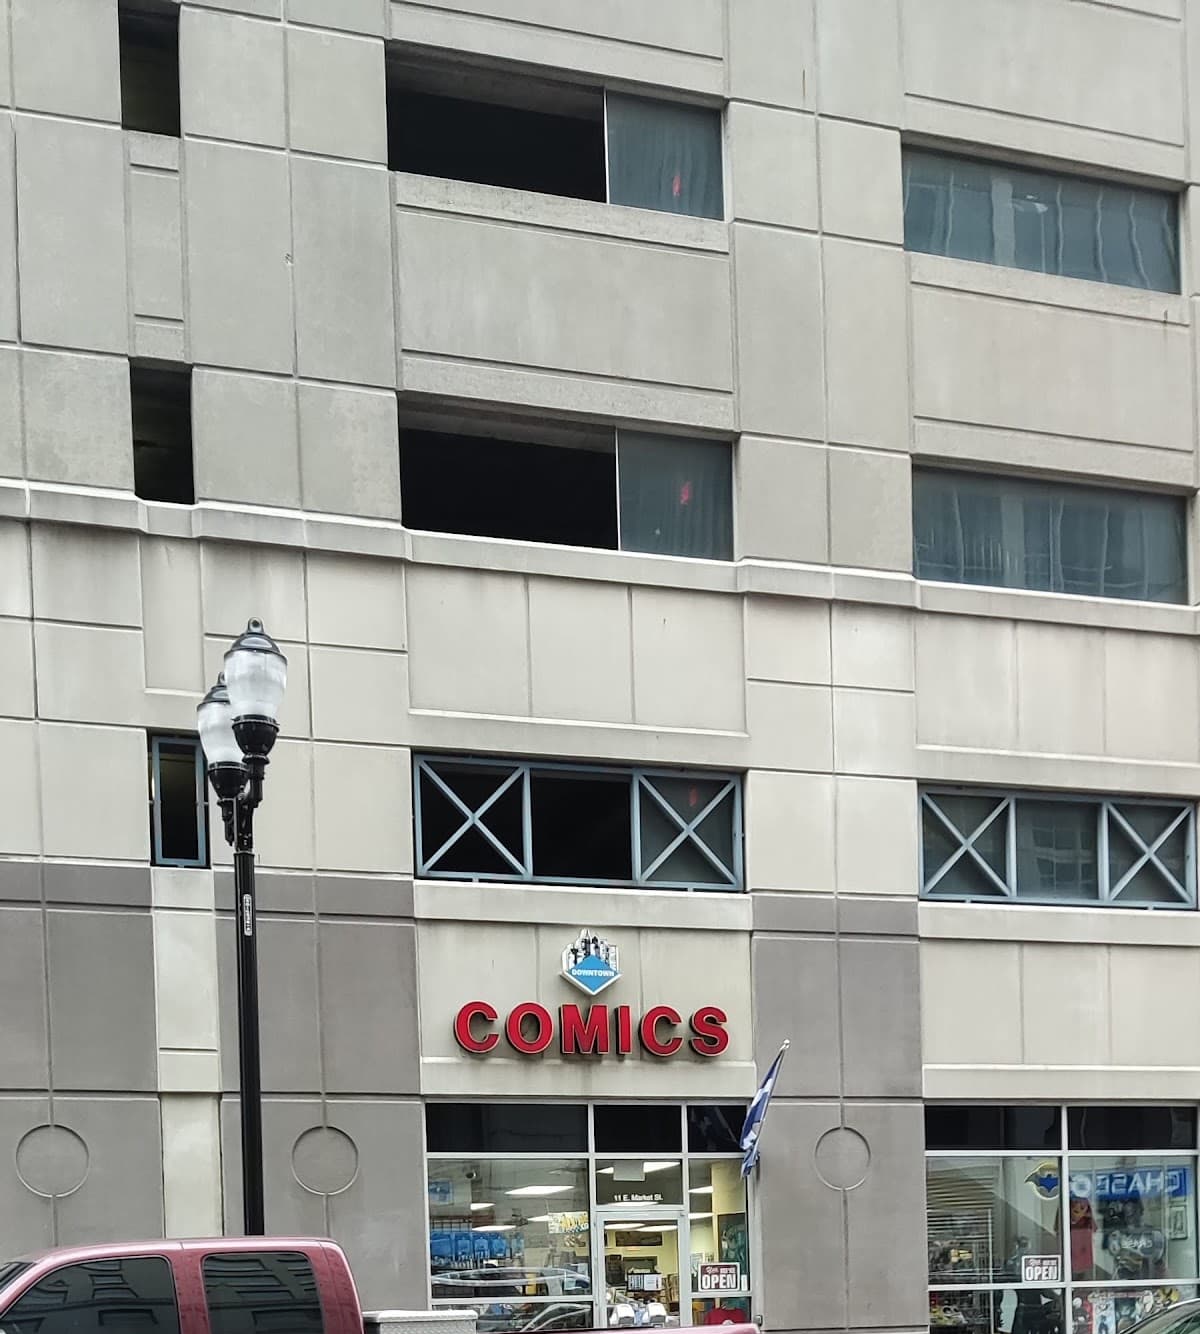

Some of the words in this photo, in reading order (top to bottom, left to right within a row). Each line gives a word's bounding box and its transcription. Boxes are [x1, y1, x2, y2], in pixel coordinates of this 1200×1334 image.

[571, 968, 615, 977] DOWNTOWN
[454, 1000, 730, 1056] COMICS
[1025, 1266, 1058, 1281] OPEN
[701, 1274, 737, 1289] OPEN
